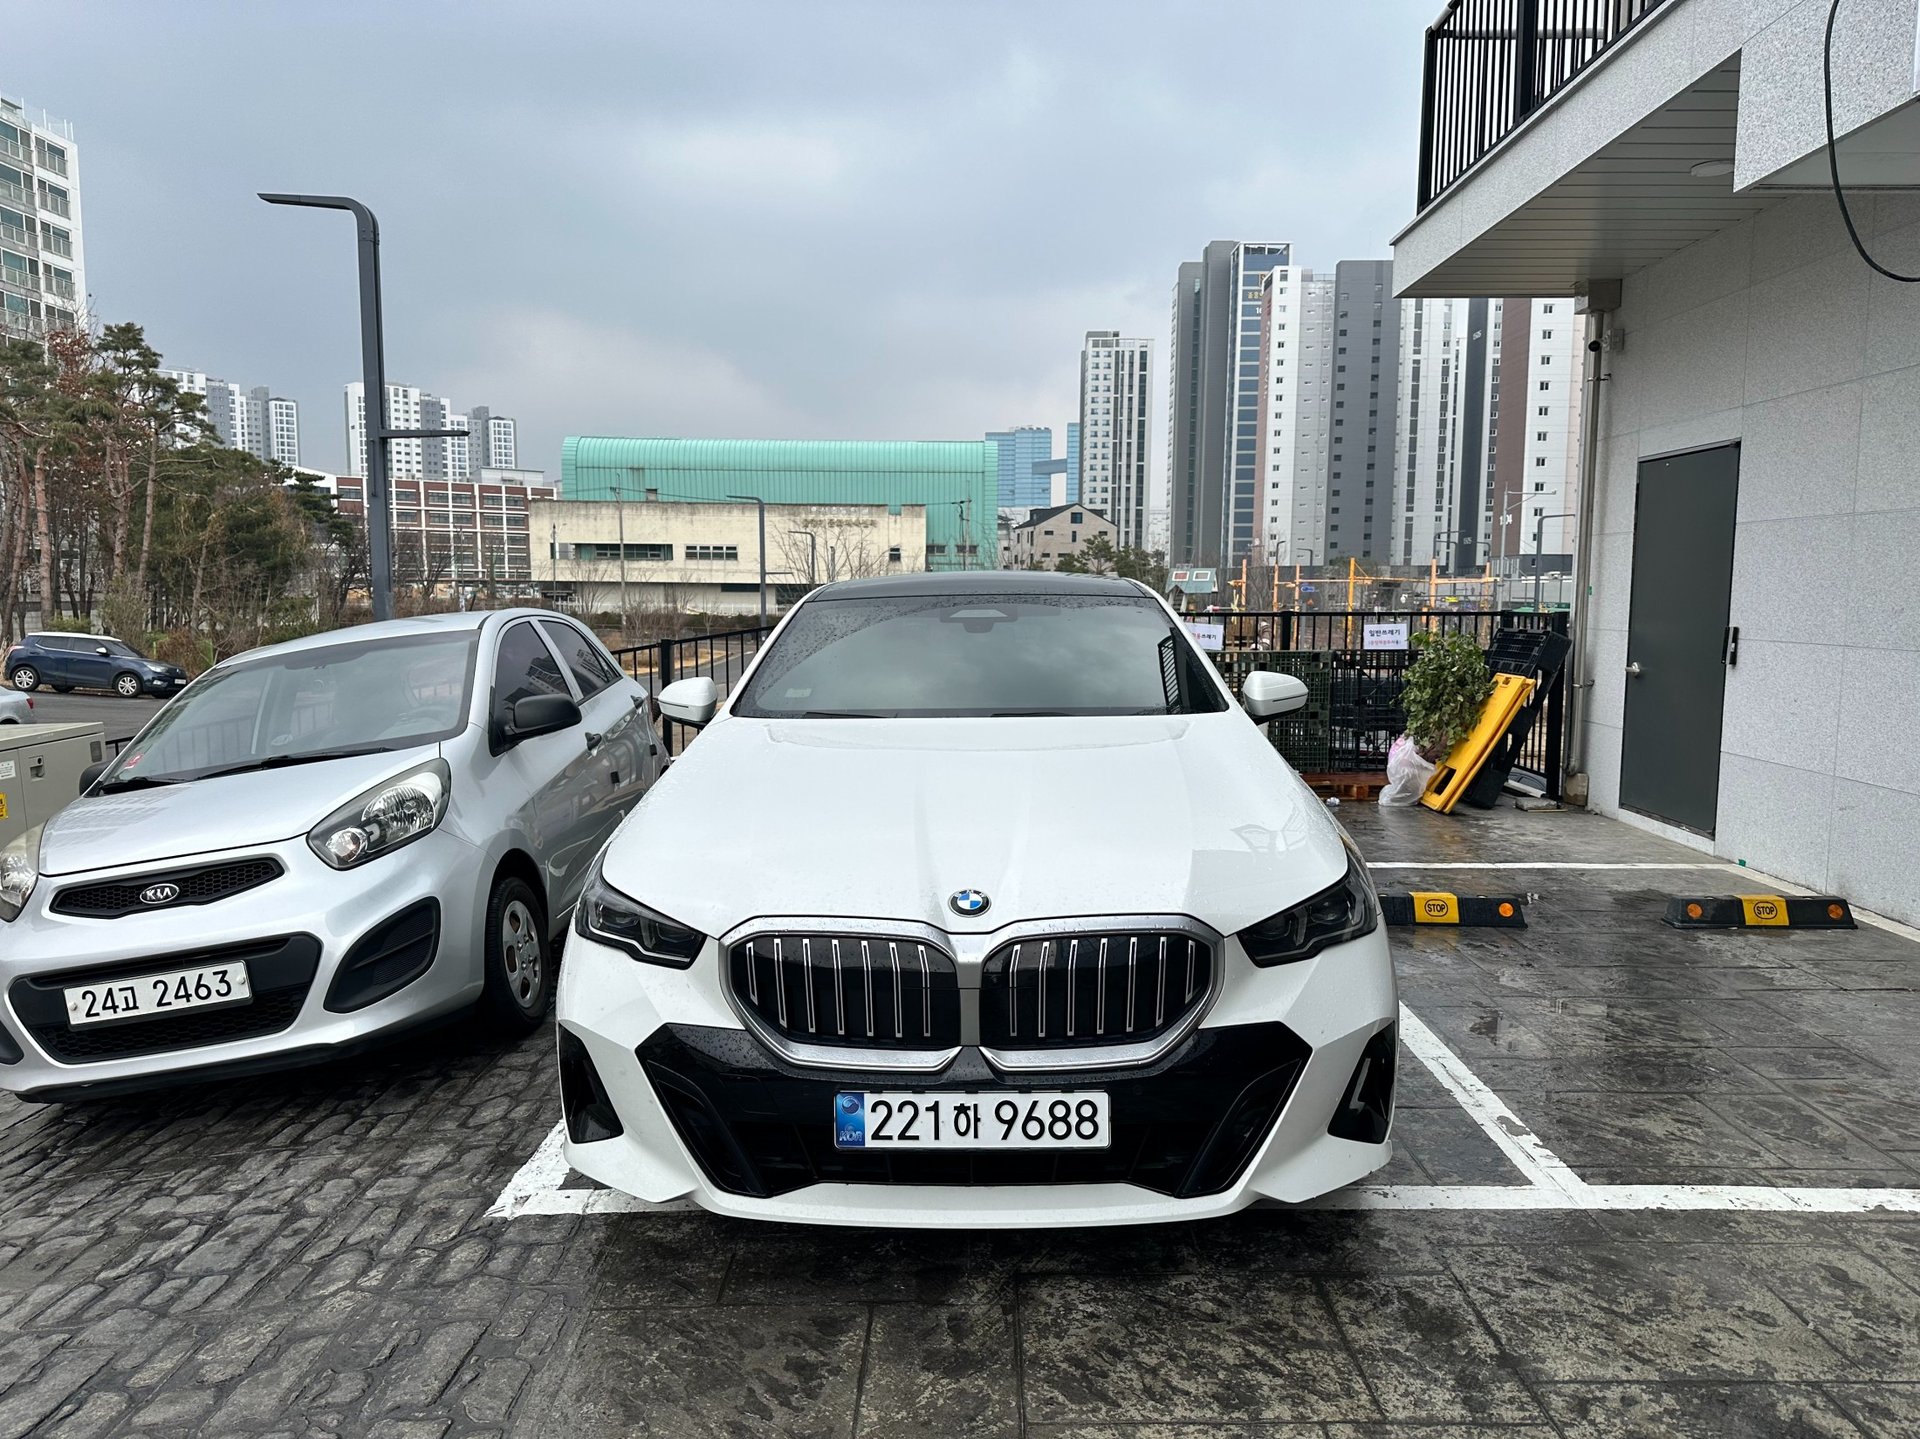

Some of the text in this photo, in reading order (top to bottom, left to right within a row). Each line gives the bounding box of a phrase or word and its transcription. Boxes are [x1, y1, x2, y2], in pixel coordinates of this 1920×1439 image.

[1368, 629, 1401, 637] 일반쓰레기
[146, 887, 172, 900] KIA
[1427, 903, 1446, 912] STOP
[1756, 905, 1775, 915] STOP
[81, 969, 232, 1018] 24고 2463
[994, 1099, 1099, 1141] 9688
